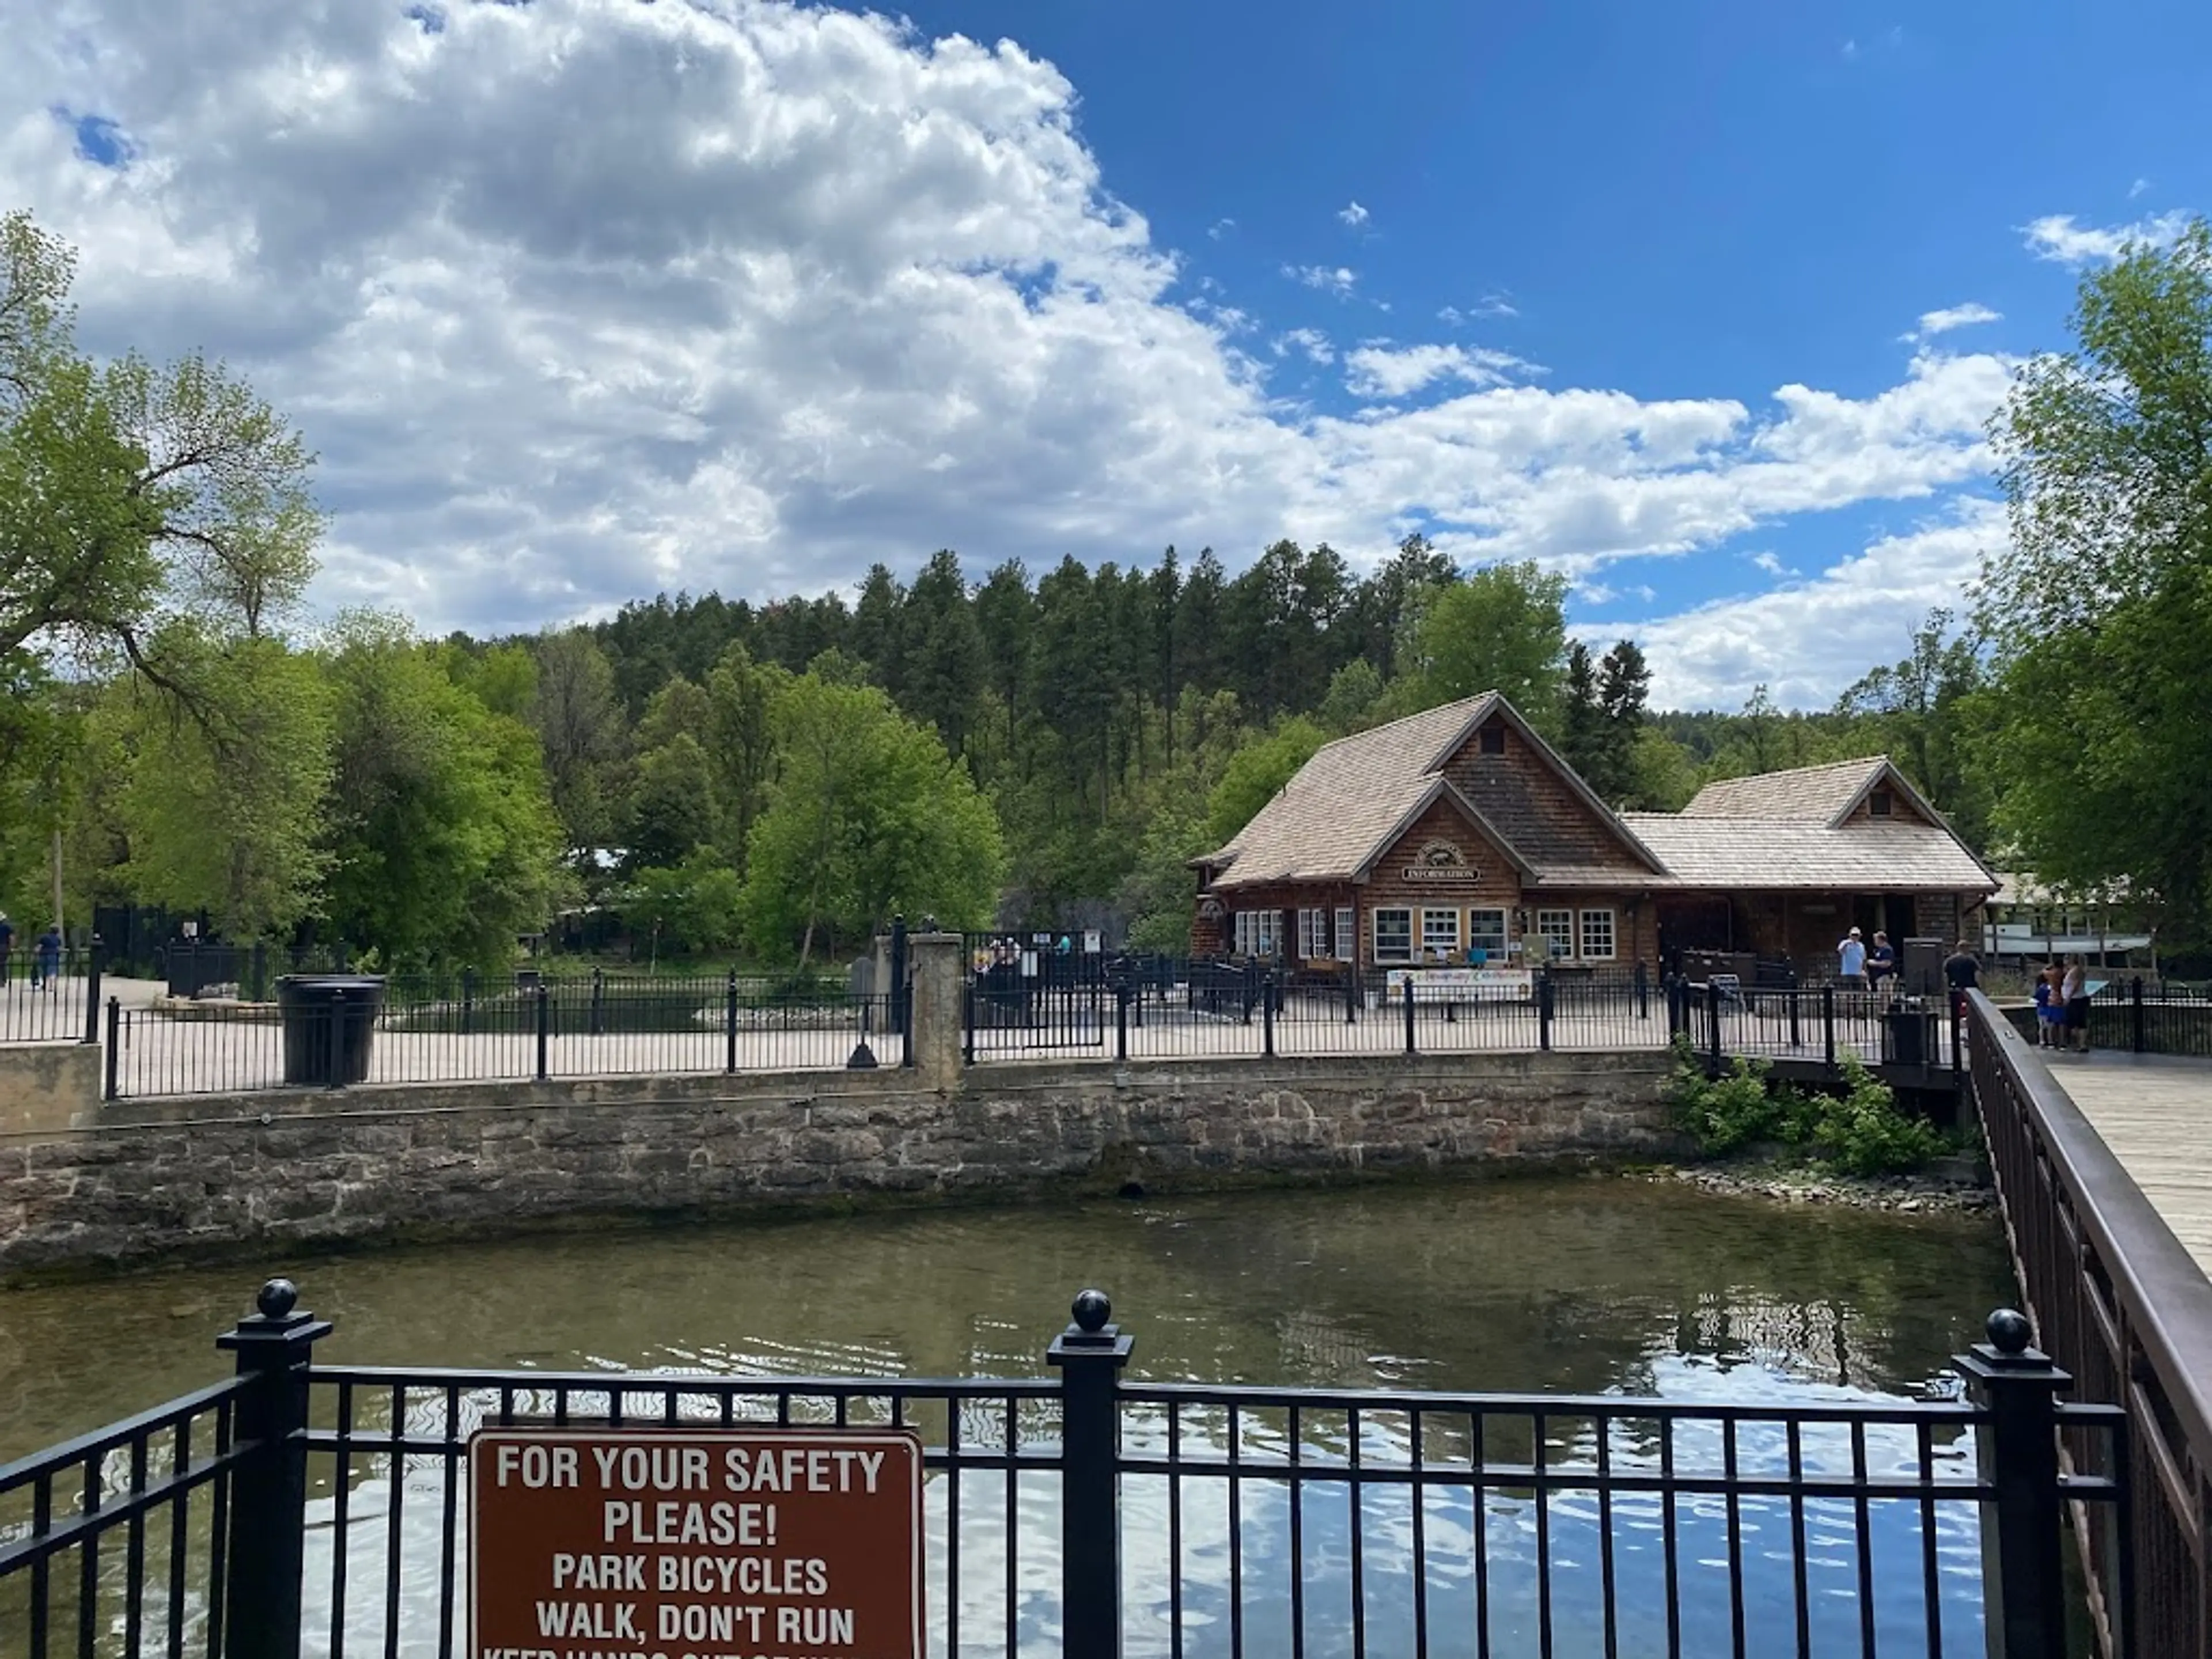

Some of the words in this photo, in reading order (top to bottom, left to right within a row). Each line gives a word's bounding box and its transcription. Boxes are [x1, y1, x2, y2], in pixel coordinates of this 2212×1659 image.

[498, 1445, 578, 1487] FOR
[592, 1447, 709, 1490] YOUR
[725, 1448, 885, 1493] SAFETY
[604, 1501, 776, 1546] PLEASE!
[554, 1554, 646, 1590] PARK
[658, 1556, 828, 1595] BICYCLES
[536, 1601, 646, 1645] WALK,
[658, 1605, 766, 1643] DON'T
[778, 1607, 854, 1645] RUN
